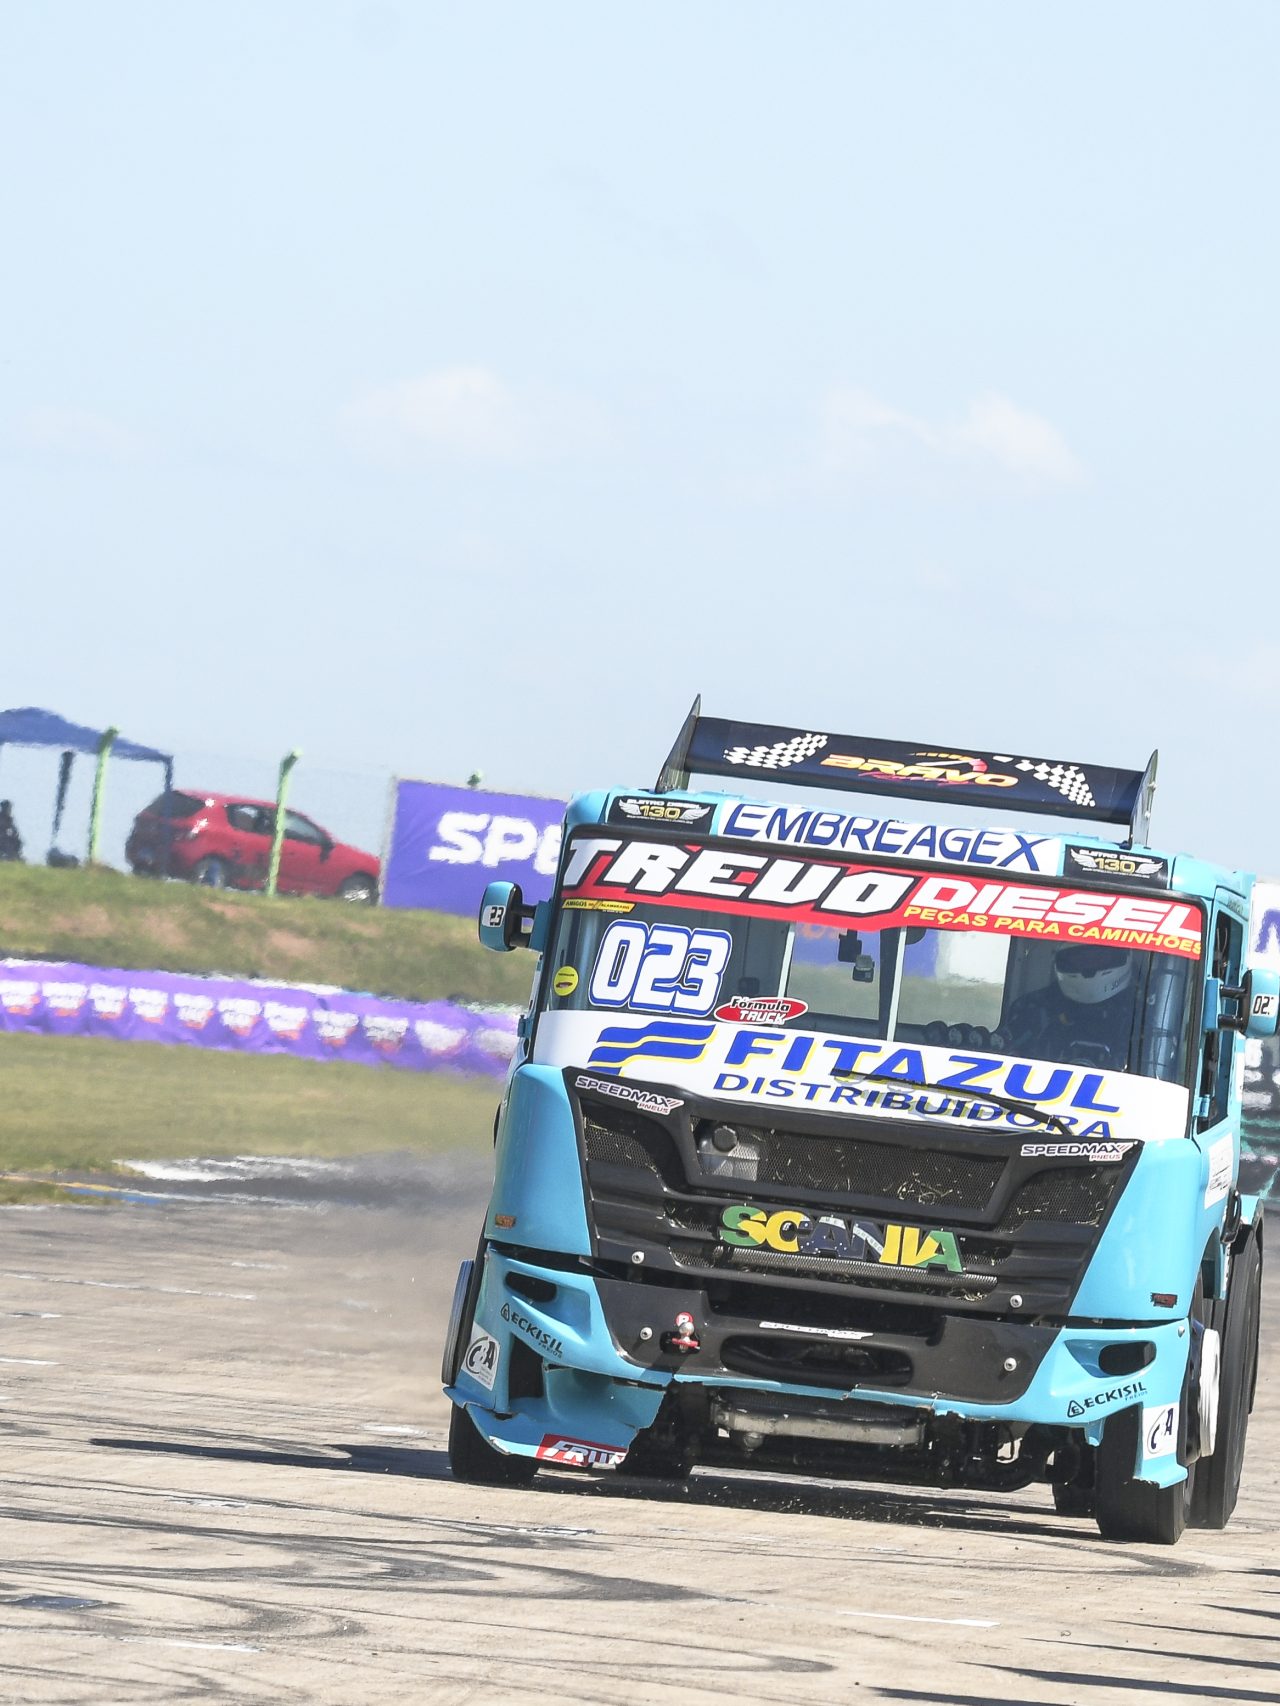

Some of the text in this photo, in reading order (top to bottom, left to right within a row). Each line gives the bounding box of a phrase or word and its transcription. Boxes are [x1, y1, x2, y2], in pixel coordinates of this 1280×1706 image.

[820, 754, 1018, 787] BRAVO
[640, 806, 681, 820] 130
[722, 803, 1043, 871] EMBREAGEX
[1095, 858, 1136, 874] 130
[904, 906, 987, 928] PEÇAS
[994, 917, 1060, 935] PARA
[911, 876, 1201, 941] DIESEL
[588, 919, 733, 1017] 023
[740, 1011, 787, 1025] TRUCK
[725, 1030, 1121, 1114] FITAZUL
[577, 1076, 672, 1108] SPEEDMAX
[713, 1074, 1112, 1138] DISTRIBUIDORA
[638, 1103, 671, 1114] PNEUS
[1022, 1144, 1124, 1157] SPEEDMAX
[1090, 1152, 1122, 1161] PNEUS
[720, 1206, 963, 1272] SCANIA
[511, 1312, 563, 1353] ECKISIL
[1084, 1382, 1147, 1408] ECKISIL
